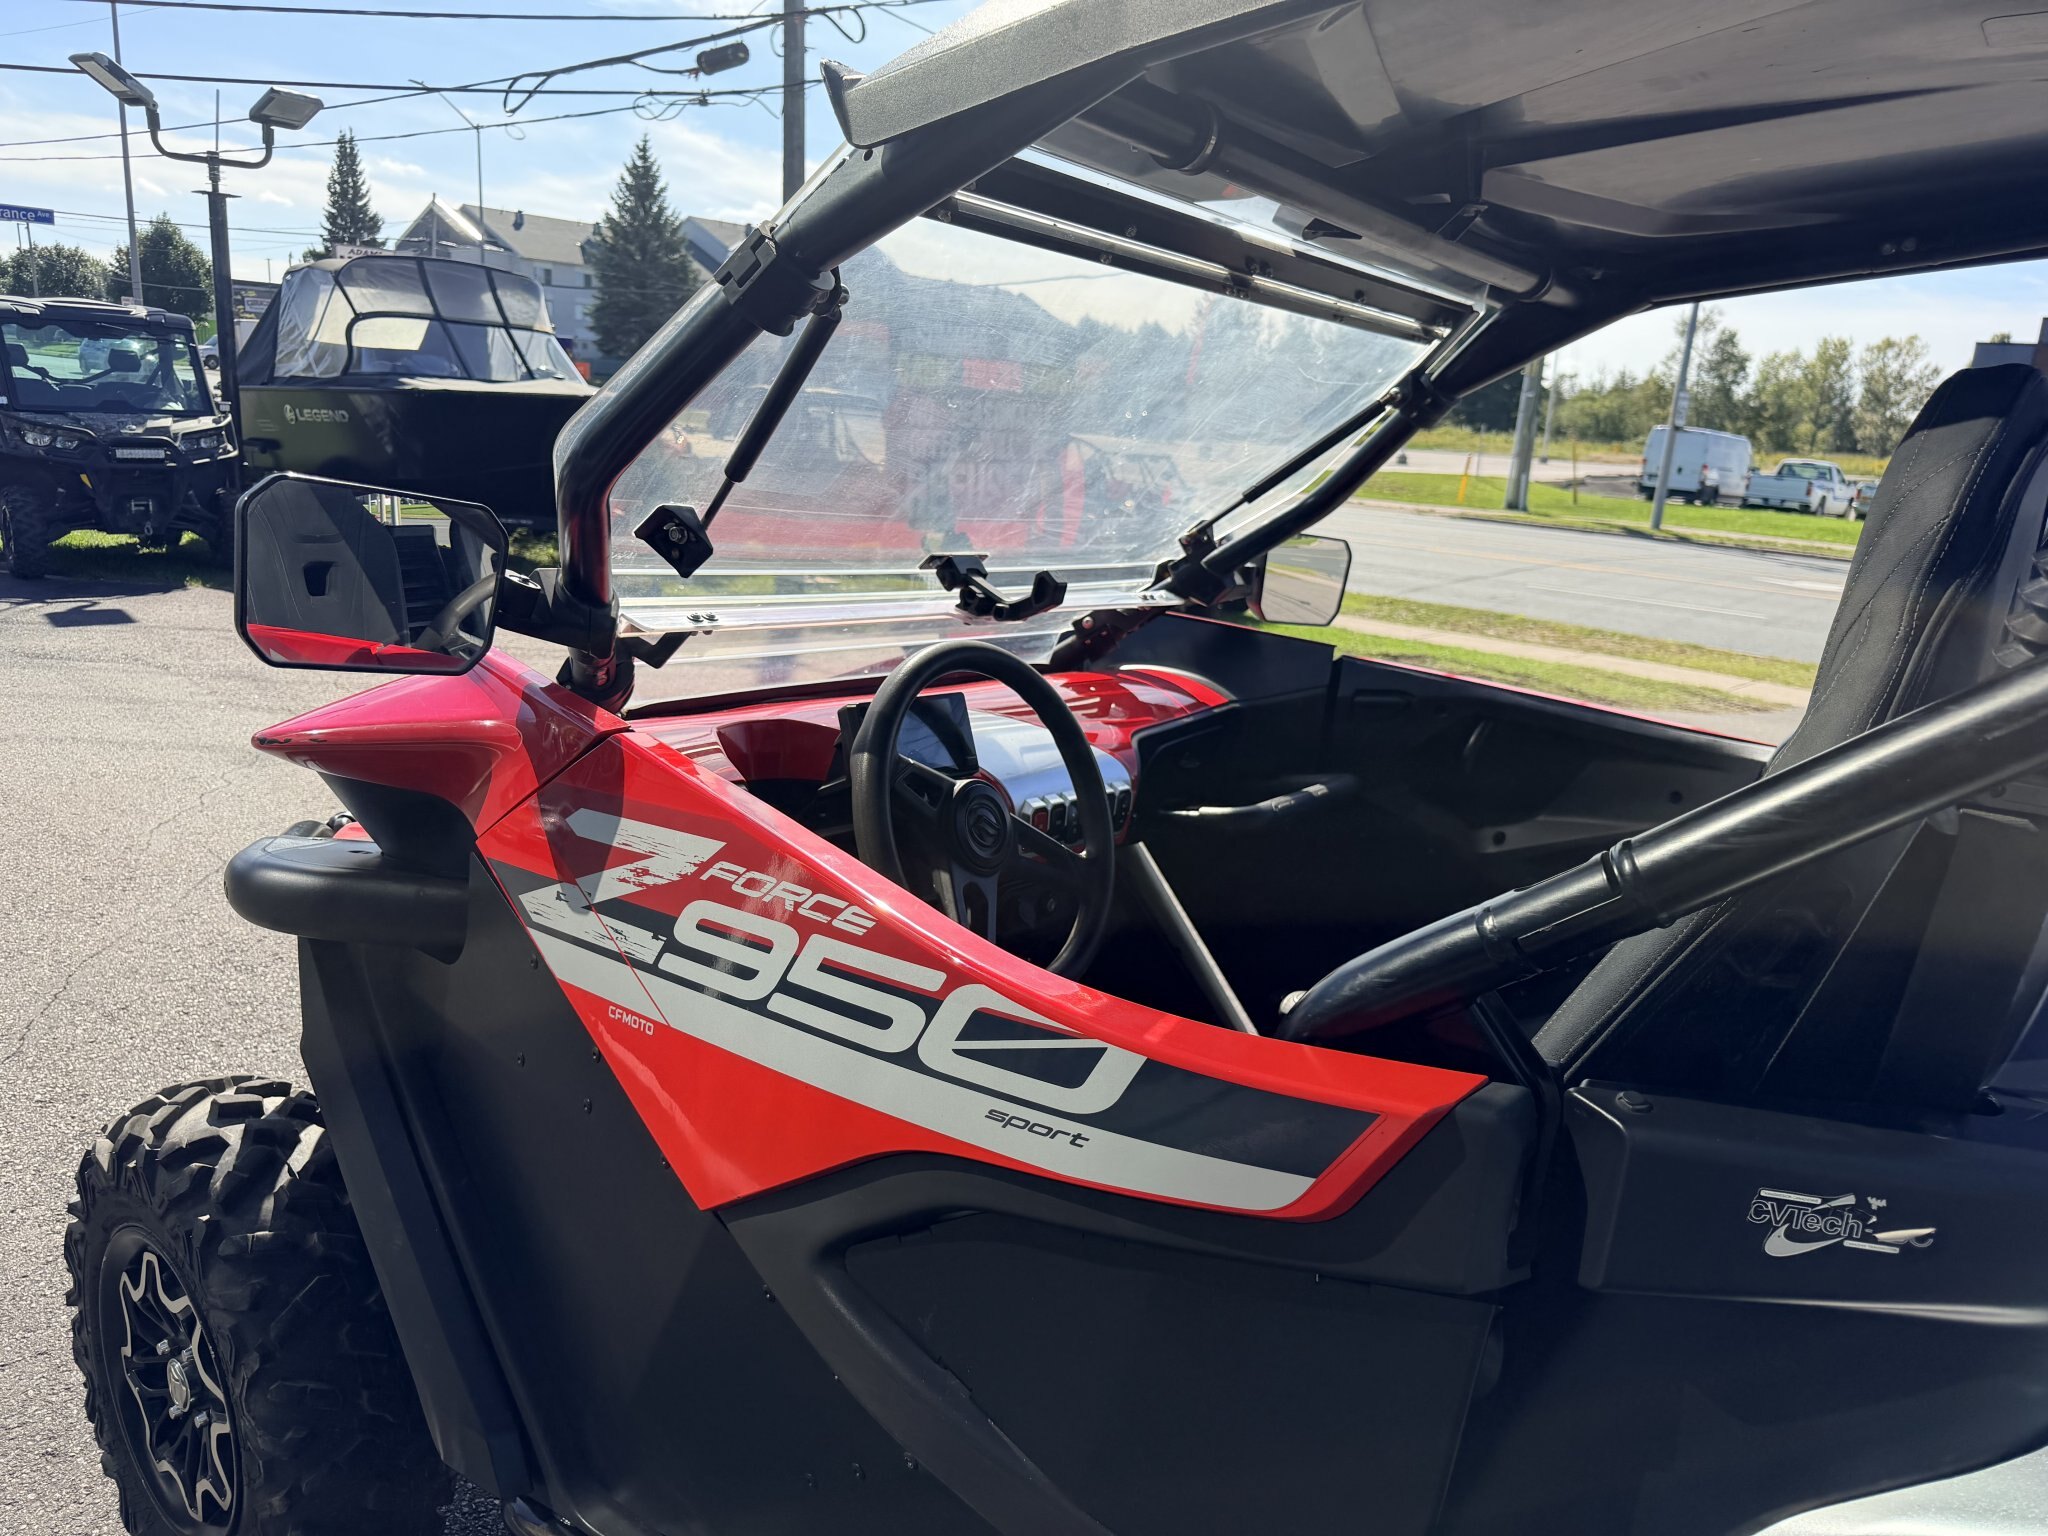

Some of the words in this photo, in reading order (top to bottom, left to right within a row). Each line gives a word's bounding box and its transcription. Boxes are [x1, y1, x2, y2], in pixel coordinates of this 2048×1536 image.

[295, 408, 349, 422] LEGEND
[700, 861, 878, 936] FORCE
[608, 1005, 654, 1036] CFMOTO
[657, 899, 1148, 1115] 950
[984, 1108, 1090, 1148] sport
